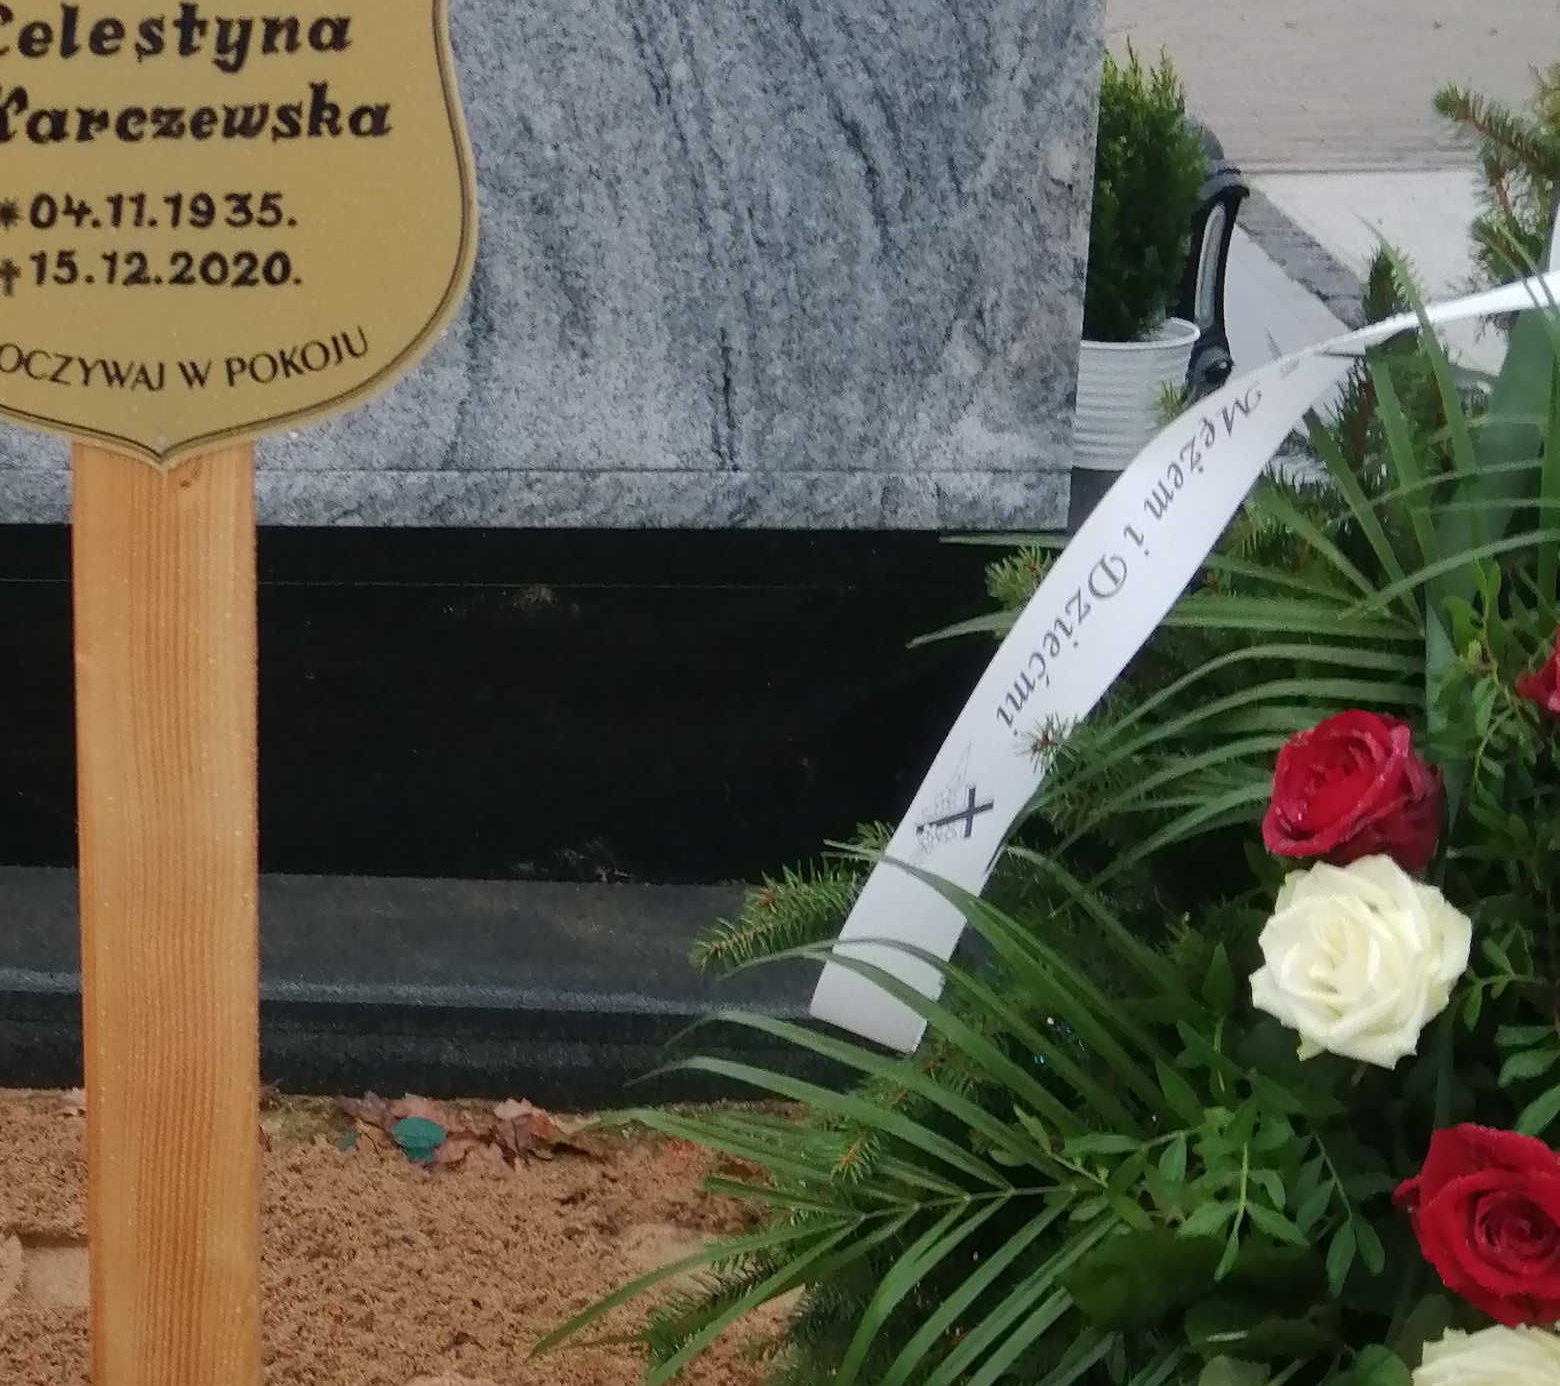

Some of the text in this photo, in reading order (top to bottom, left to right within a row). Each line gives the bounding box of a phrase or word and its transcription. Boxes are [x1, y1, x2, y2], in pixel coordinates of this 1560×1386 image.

[177, 360, 213, 390] W
[224, 325, 371, 391] POKOJU
[996, 383, 1262, 738] Mężem i Dziećmi
